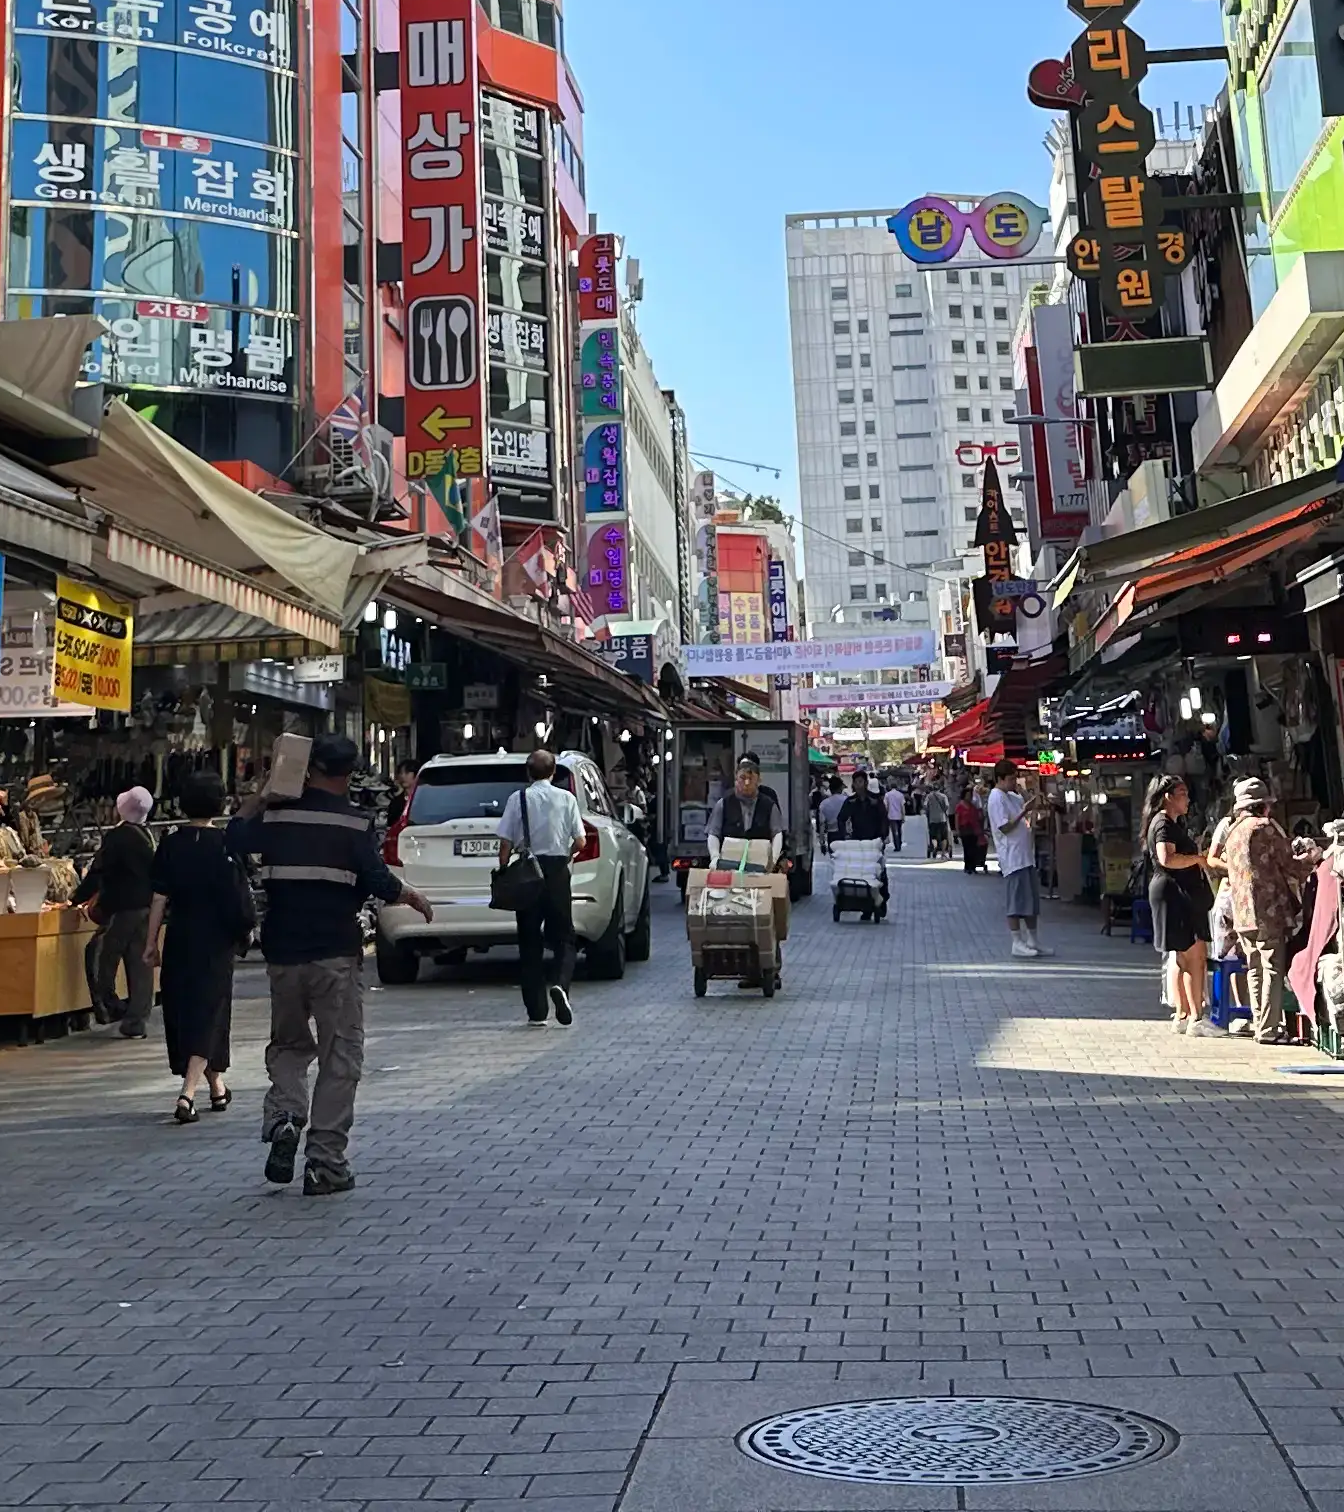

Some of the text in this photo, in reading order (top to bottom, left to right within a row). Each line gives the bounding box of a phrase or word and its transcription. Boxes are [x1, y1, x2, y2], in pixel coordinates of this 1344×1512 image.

[37, 12, 287, 65] Korean Folkcraft
[153, 131, 200, 151] 1층
[34, 183, 286, 227] General Merchandise
[916, 212, 1023, 246] 남도
[594, 238, 615, 313] 그릇도매
[148, 302, 200, 321] 지하
[188, 327, 285, 377] 명품
[597, 331, 618, 410] 민속공예
[179, 366, 288, 394] Merchandise
[601, 425, 620, 507] 생활잡화
[604, 527, 625, 610] 수입명품
